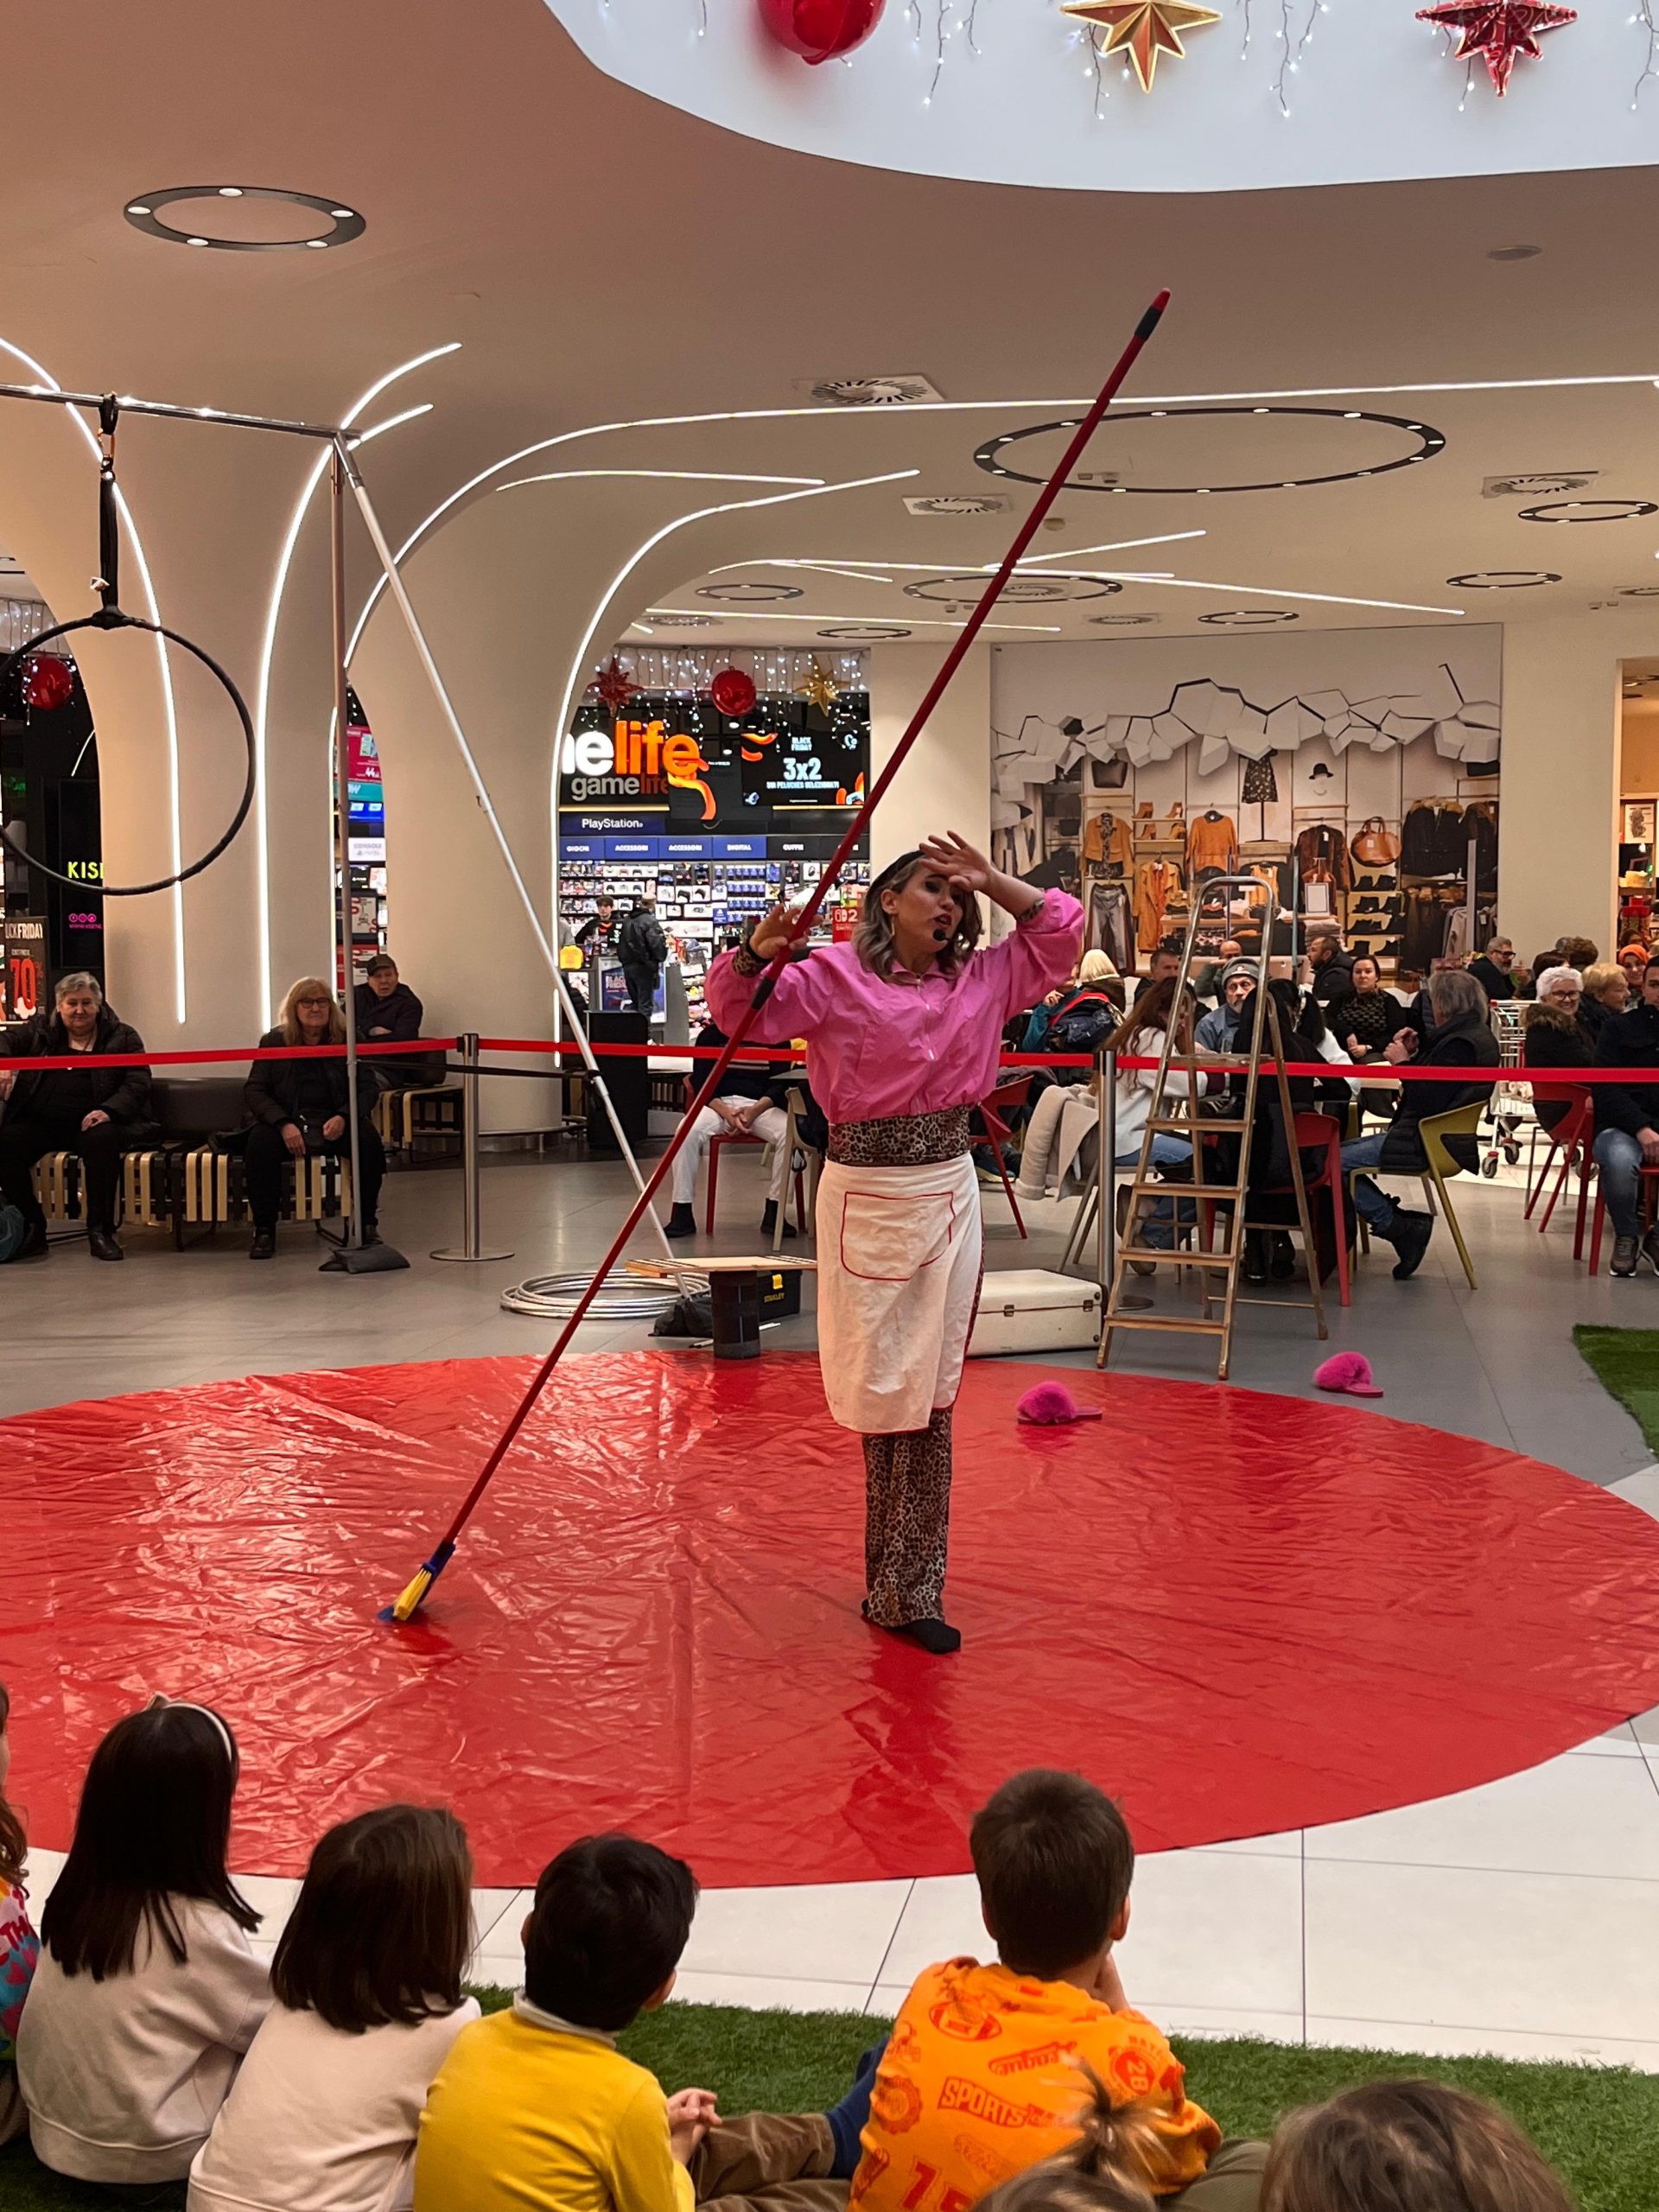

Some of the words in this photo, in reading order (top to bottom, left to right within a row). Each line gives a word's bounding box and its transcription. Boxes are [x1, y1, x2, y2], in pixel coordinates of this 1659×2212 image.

[783, 757, 822, 780] 3x2
[582, 819, 639, 830] PlayStation
[764, 1293, 785, 1303] STANLEY
[938, 2076, 1030, 2128] SPORTS
